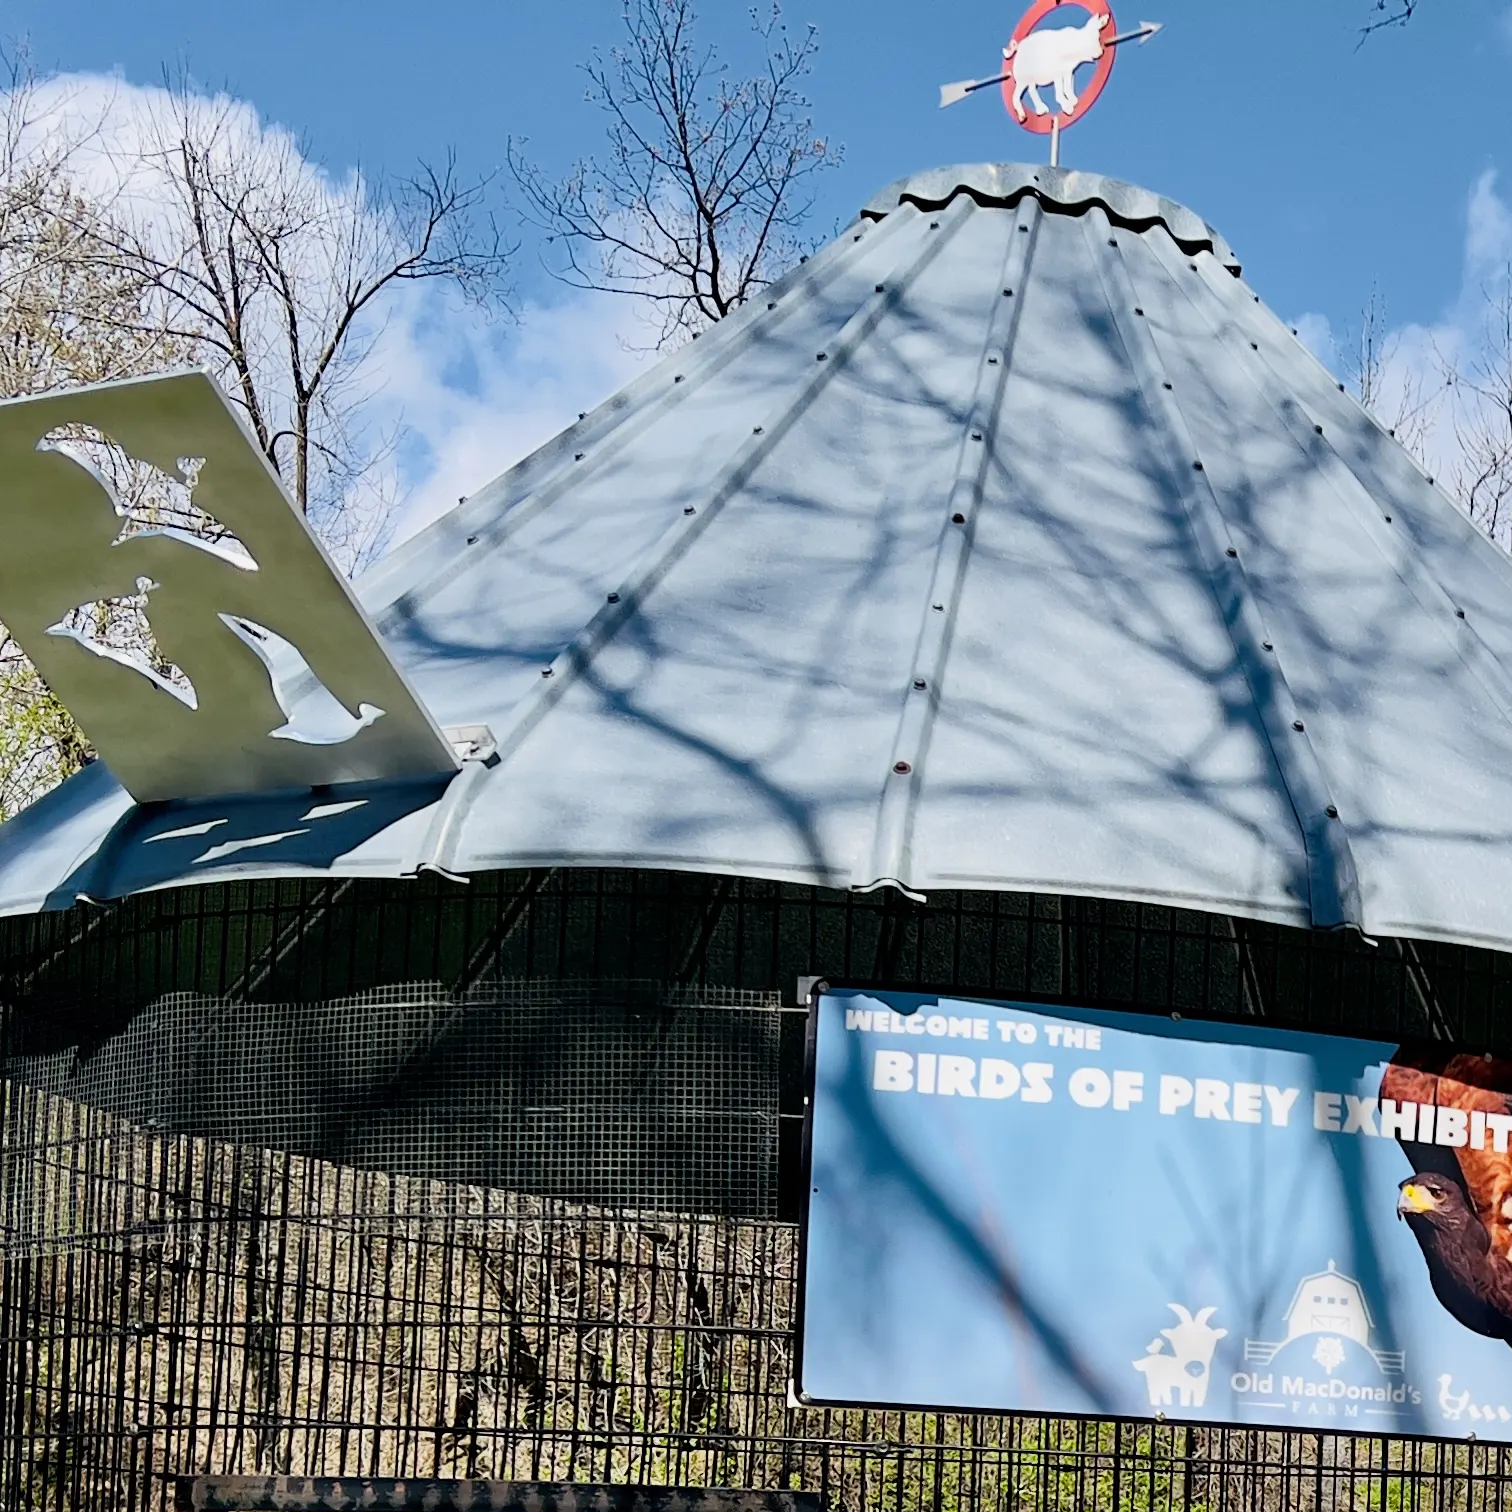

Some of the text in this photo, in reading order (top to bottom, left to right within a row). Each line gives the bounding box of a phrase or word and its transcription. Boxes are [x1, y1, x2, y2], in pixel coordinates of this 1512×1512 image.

[845, 1009, 1102, 1051] WELCOME TO THE
[873, 1050, 1054, 1104] BIRDS
[1068, 1067, 1144, 1111] OF
[1159, 1074, 1301, 1127] PREY
[1230, 1372, 1422, 1405] Old MacDonald's
[1292, 1401, 1359, 1418] FARM
